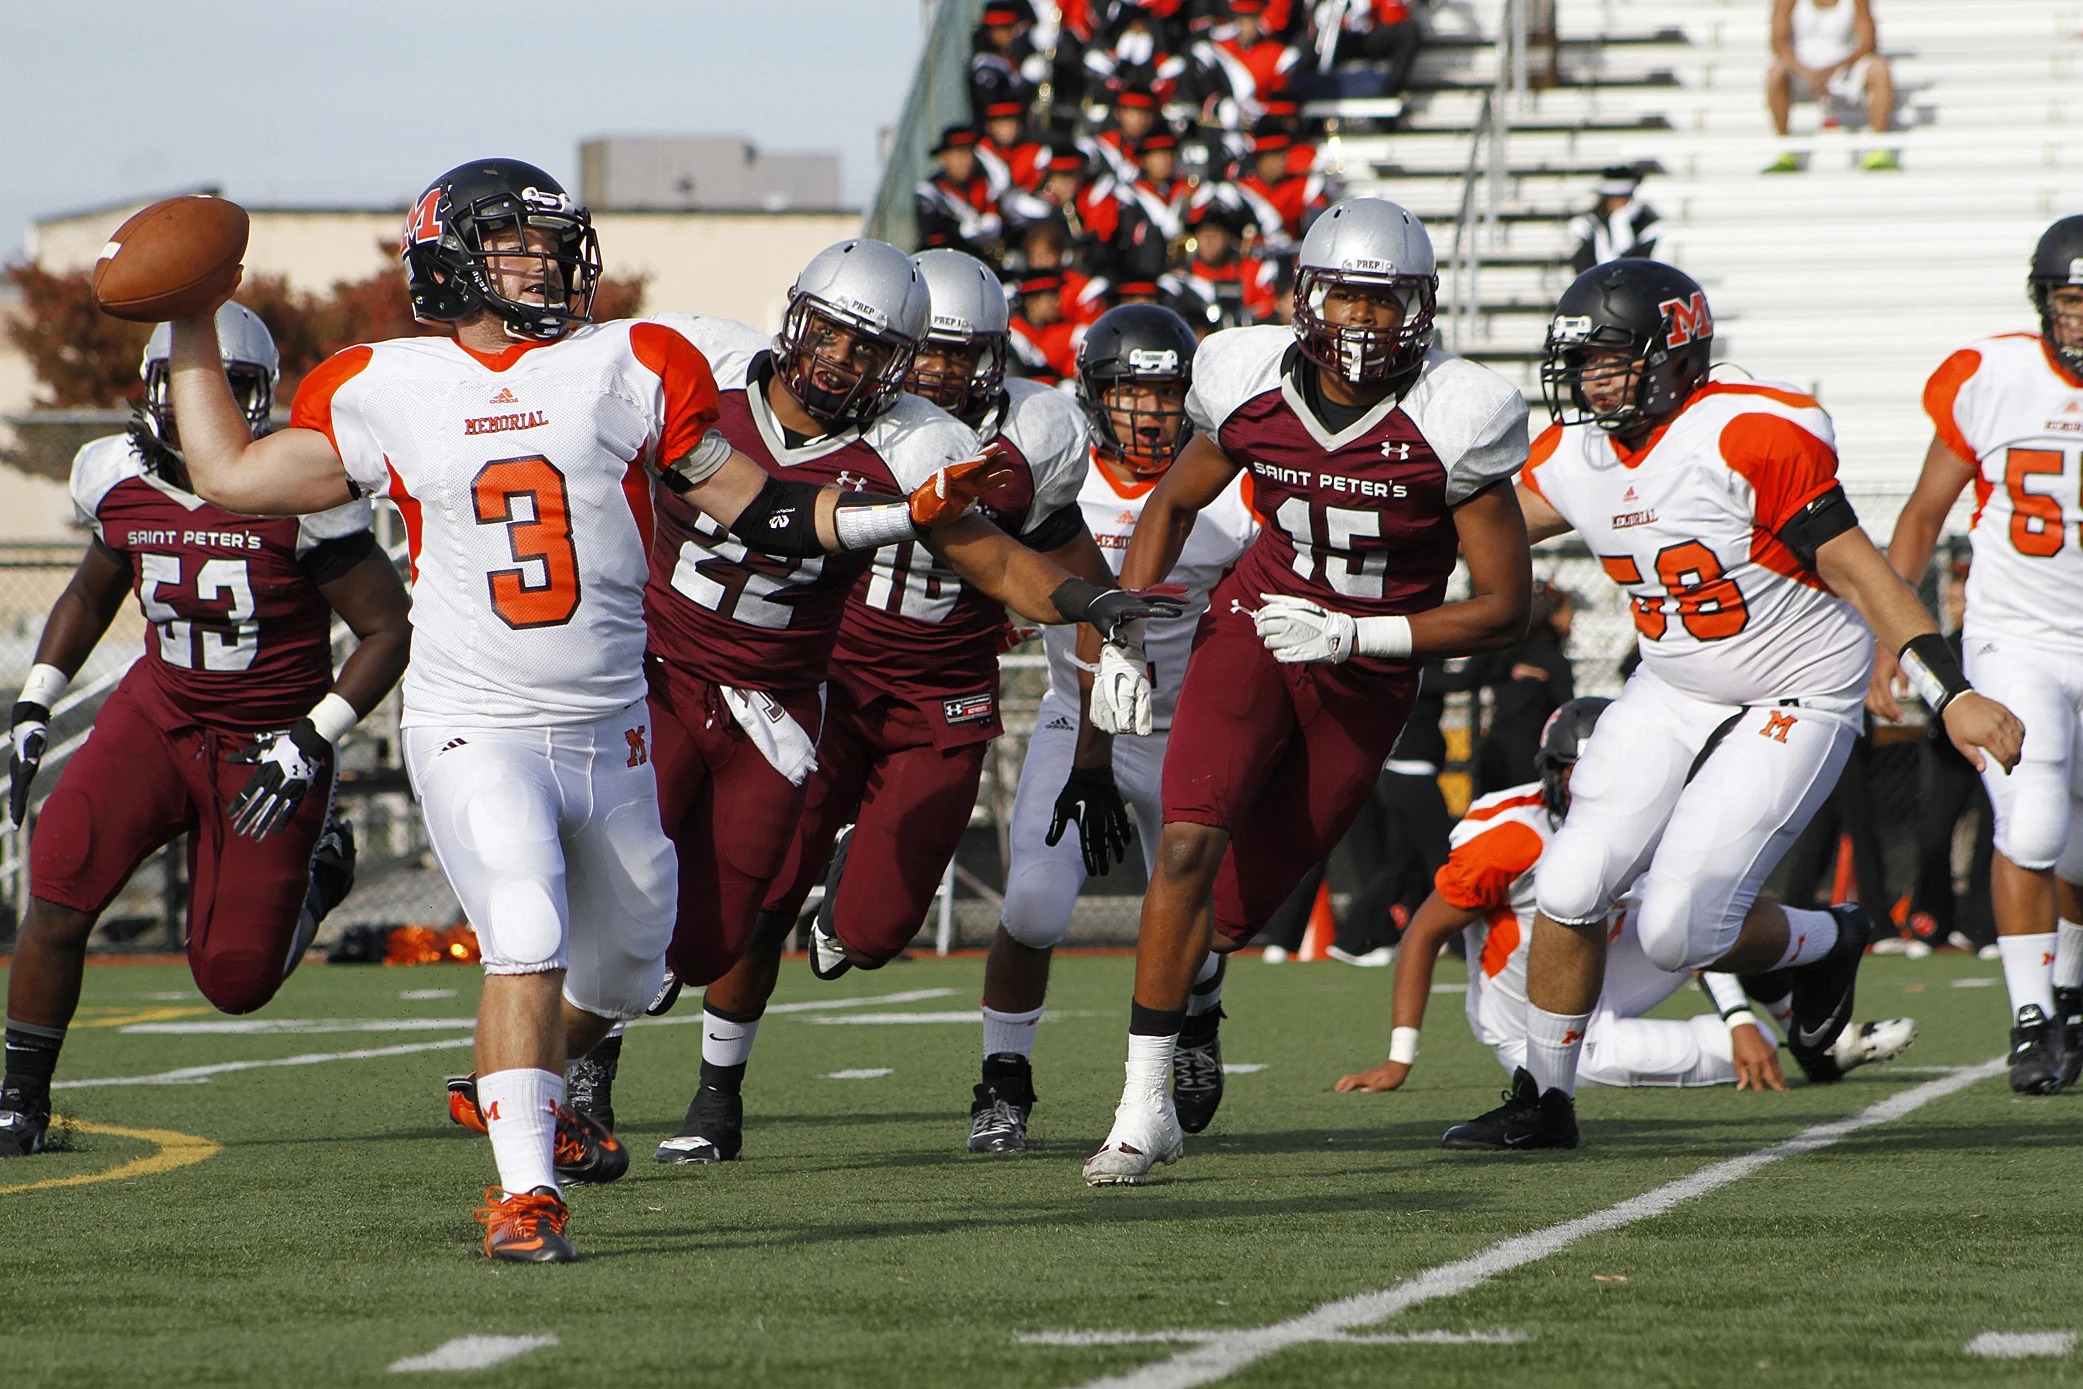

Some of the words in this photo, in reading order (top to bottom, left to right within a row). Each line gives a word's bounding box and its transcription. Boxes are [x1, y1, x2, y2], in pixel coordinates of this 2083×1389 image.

[400, 184, 453, 258] M
[1355, 259, 1380, 270] PREP
[851, 299, 875, 316] PREP
[933, 315, 957, 327] PREP
[1658, 290, 1715, 350] M
[464, 411, 549, 436] MEMORIAL
[1253, 461, 1312, 487] SAINT
[1319, 473, 1408, 499] PETER'S
[127, 529, 177, 546] SAINT
[182, 529, 262, 550] PETER'S
[470, 454, 582, 631] 3
[1275, 496, 1388, 600] 15
[139, 552, 260, 672] 53
[1758, 709, 1799, 744] M
[623, 725, 648, 768] M
